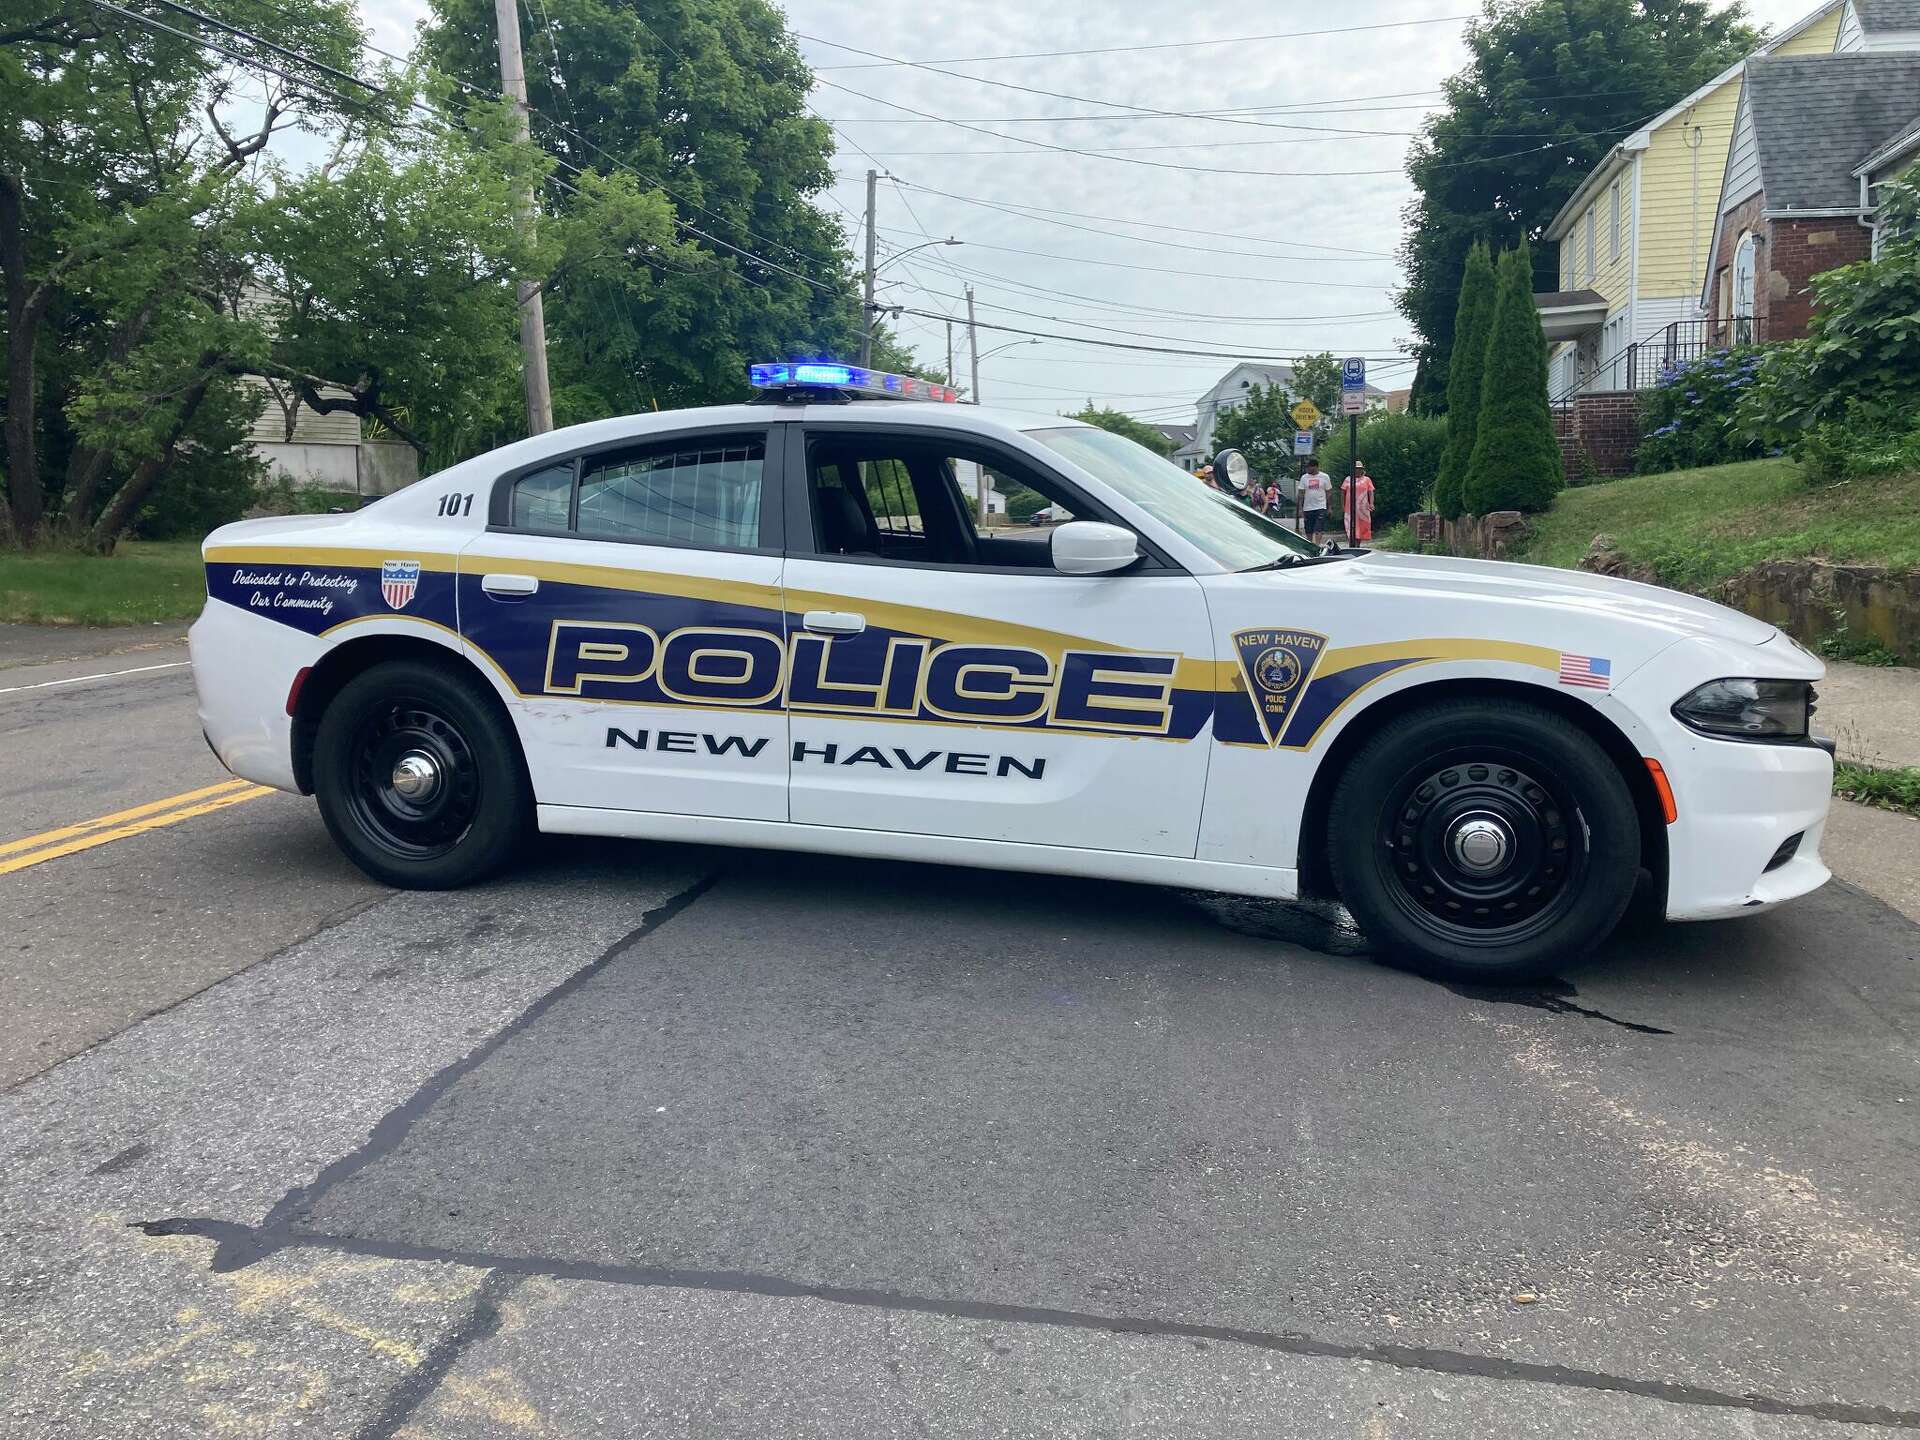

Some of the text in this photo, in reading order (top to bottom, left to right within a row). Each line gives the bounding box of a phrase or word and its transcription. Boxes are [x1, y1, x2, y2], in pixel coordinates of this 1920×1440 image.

[437, 492, 474, 517] 101
[232, 569, 358, 594] Dedicated to Protecting
[250, 591, 334, 615] Our Community
[1239, 634, 1320, 649] NEW HAVEN
[543, 619, 1184, 734] POLICE
[1265, 694, 1287, 704] POLICE
[1265, 704, 1285, 713] CONN.
[605, 727, 1047, 780] NEW HAVEN
